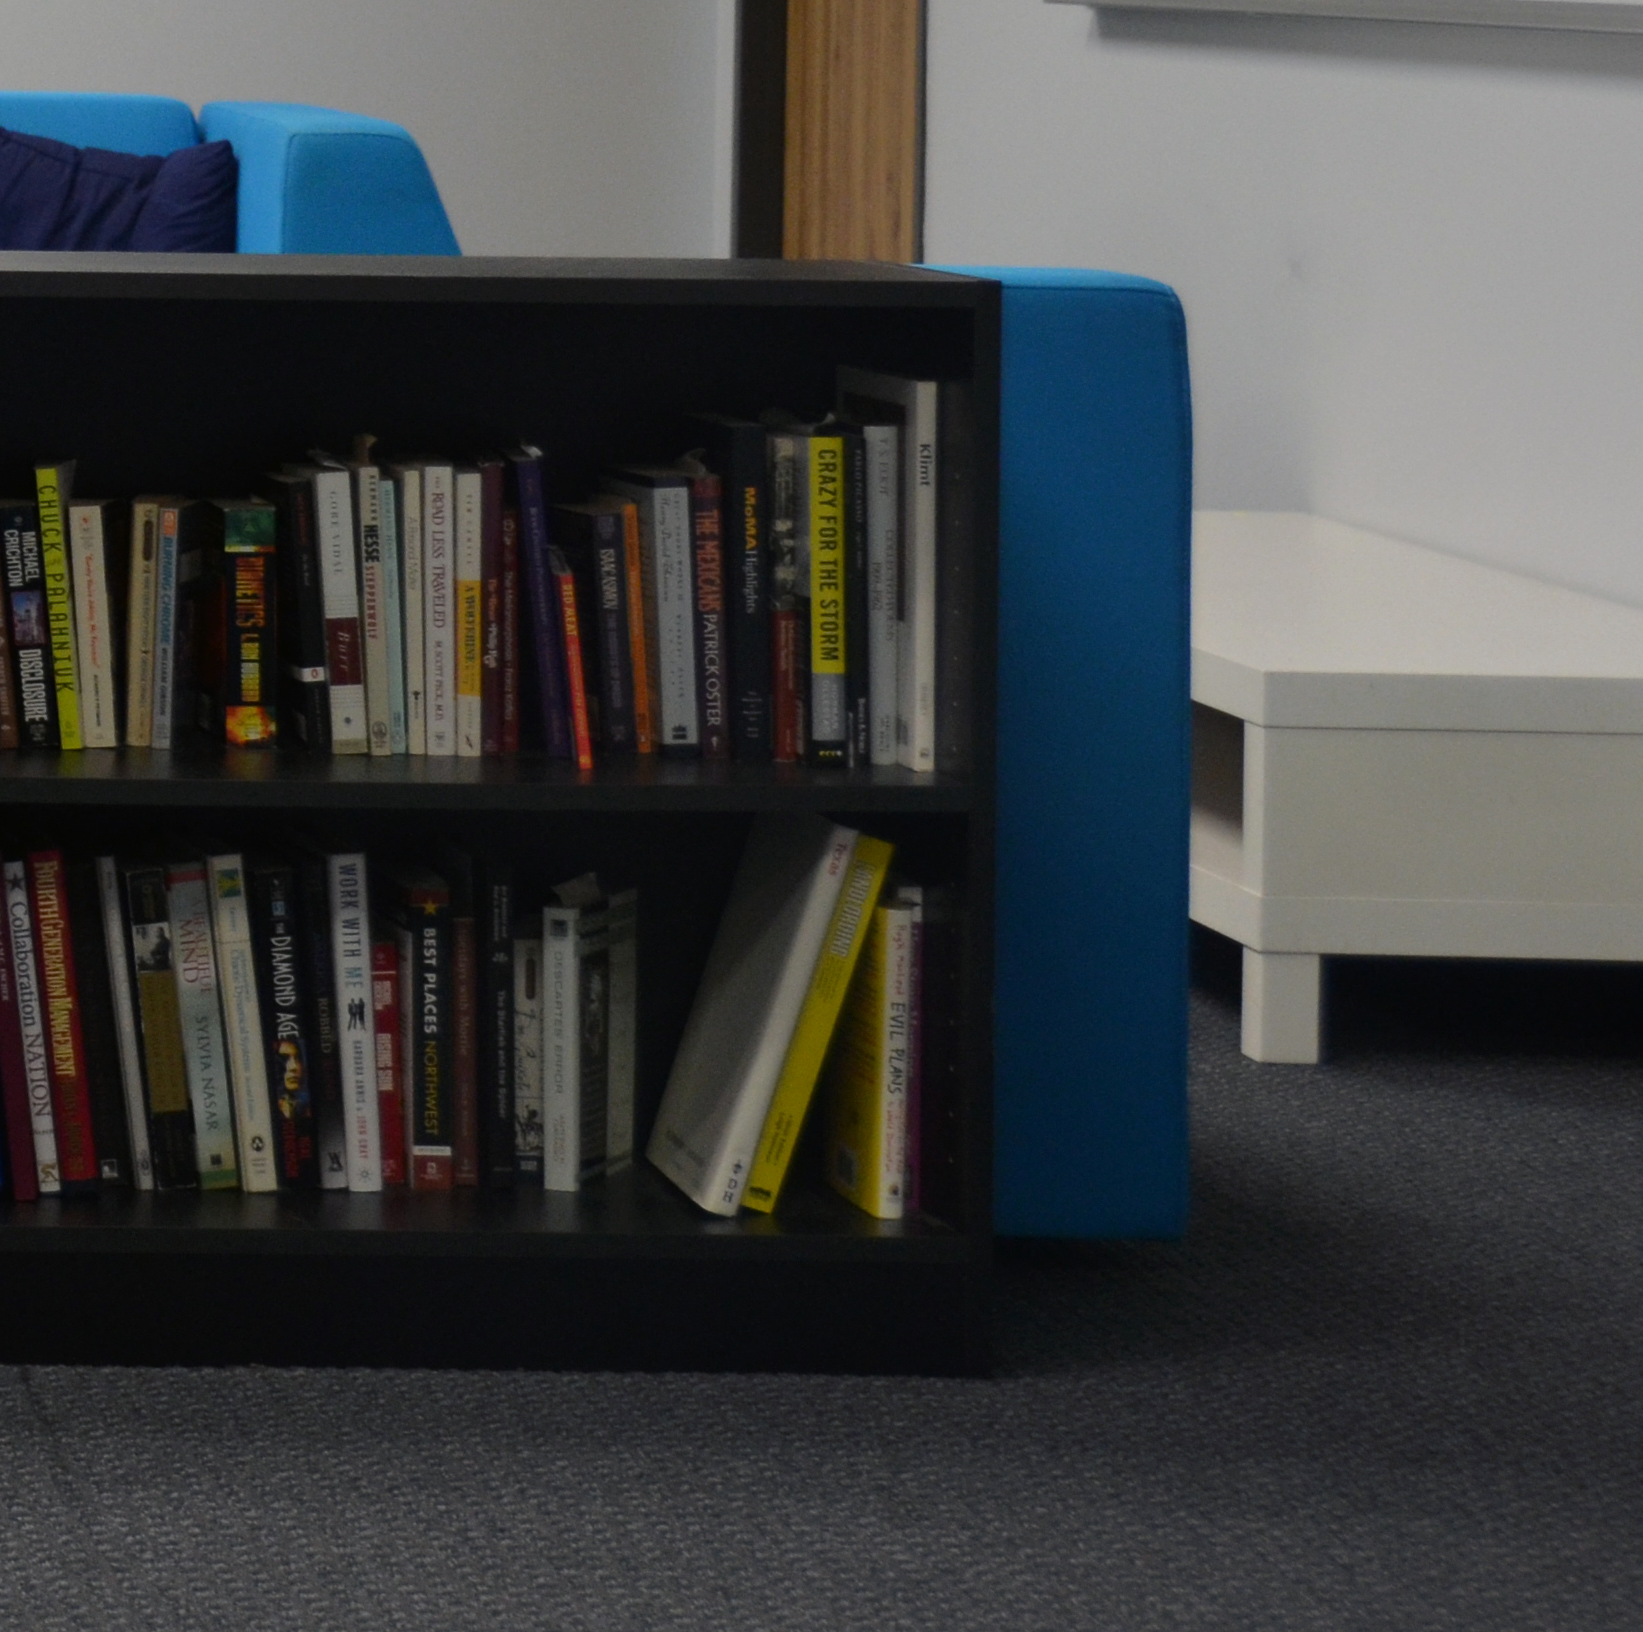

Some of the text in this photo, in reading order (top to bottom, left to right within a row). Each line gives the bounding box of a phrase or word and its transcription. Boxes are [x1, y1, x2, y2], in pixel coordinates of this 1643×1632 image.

[919, 443, 932, 487] Klimt
[432, 492, 444, 526] ROAD
[4, 529, 23, 587] CRICHTON
[24, 531, 40, 582] MICHAEL
[162, 536, 174, 592] BURNING
[432, 530, 445, 559] LESS
[742, 486, 758, 613] MoMA Highlights
[818, 449, 839, 661] CRAZY FOR THE STORM
[38, 485, 74, 692] CHUCK PALAHNIUK
[234, 556, 266, 628] DIANETICS
[363, 524, 380, 640] HESSE STEPPENWOLF
[433, 564, 445, 629] TRAVELED
[562, 584, 576, 637] RED MEAT
[160, 594, 172, 645] CHROME
[695, 509, 722, 726] THE MEXICANS PATRICK OSTER
[19, 649, 48, 722] DISCLOSURE
[827, 843, 849, 876] Texas
[33, 861, 59, 918] FOURTH
[178, 918, 198, 984] MIND
[338, 863, 363, 989] WORK WITH ME
[0, 968, 8, 1001] ESCHER
[39, 919, 72, 997] GENERATION
[9, 902, 52, 1118] Collaboration NATION
[270, 936, 299, 1040] DIAMOND AGE
[497, 990, 507, 1007] The
[48, 995, 76, 1077] MANAGEMENT
[317, 998, 333, 1054] ROBBED
[423, 928, 439, 1135] BEST PLACES NORTHWEST
[889, 1002, 906, 1040] EVIL
[196, 1016, 218, 1131] SYLVIA NASAR
[498, 1050, 507, 1068] and
[498, 1071, 507, 1084] the
[555, 1044, 564, 1094] ERROR
[888, 1049, 906, 1094] PLANS
